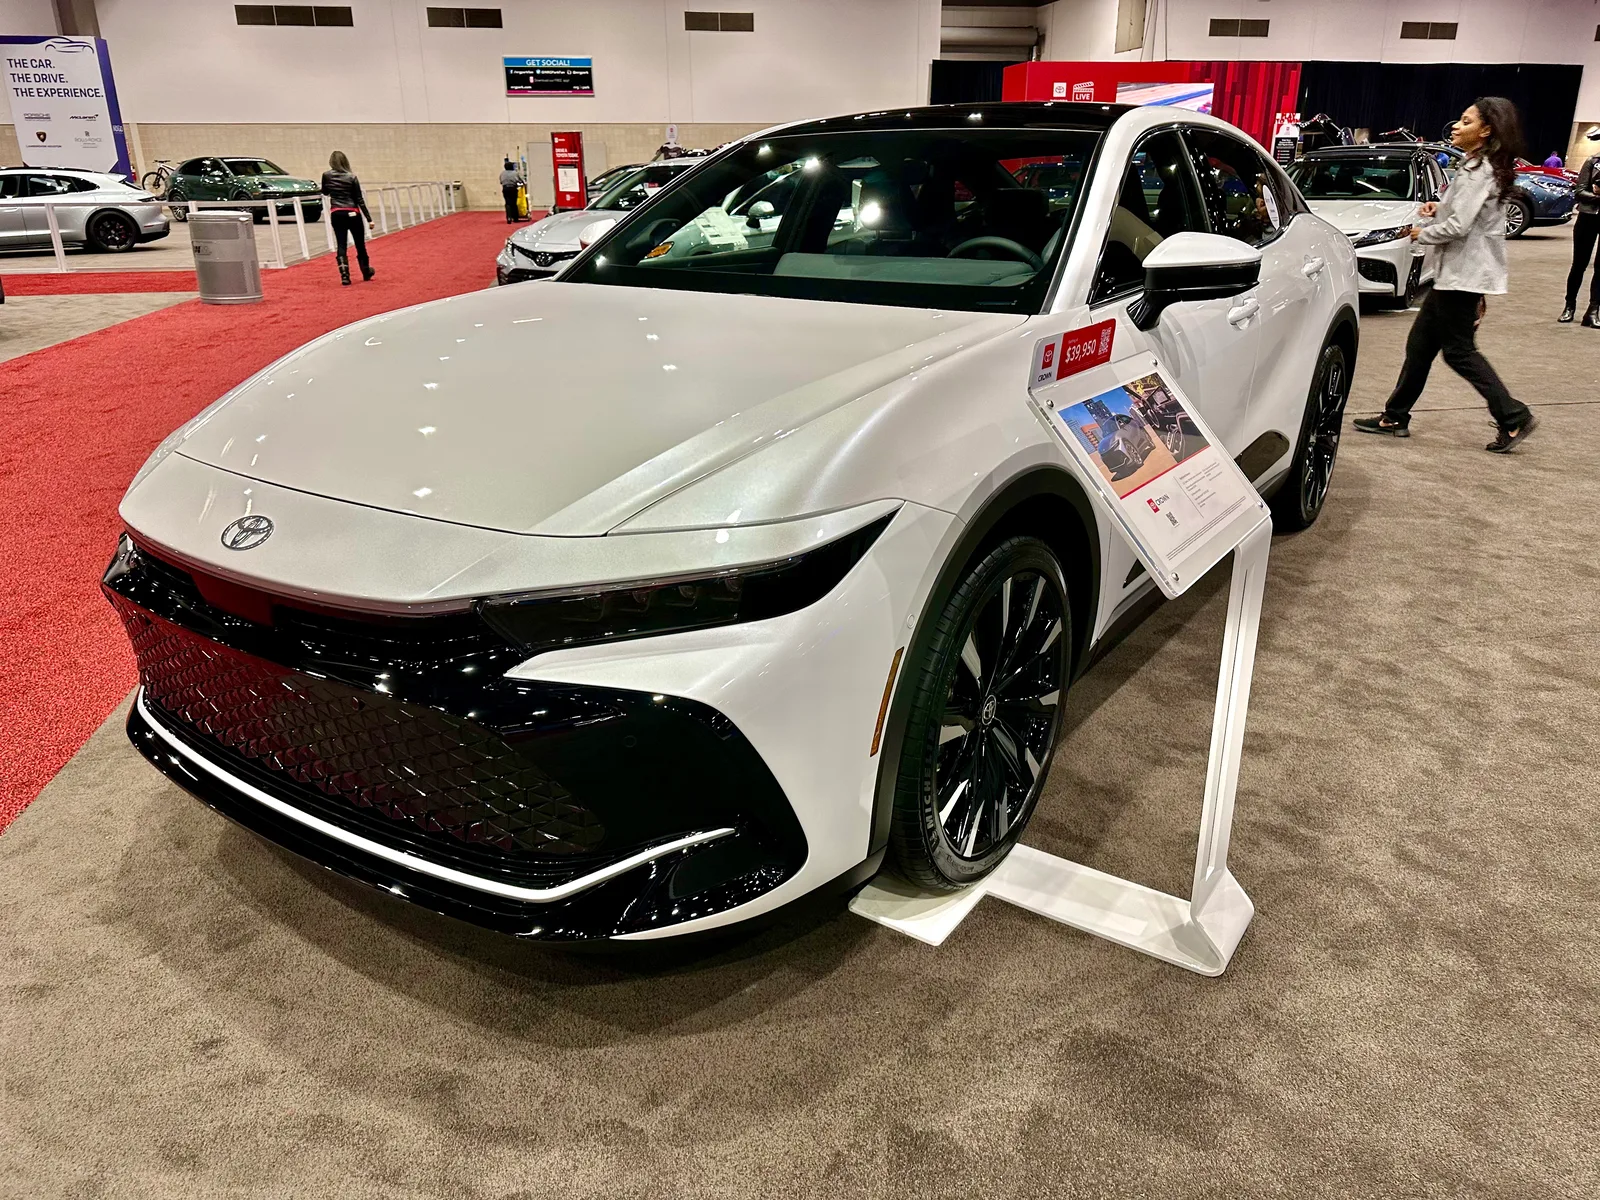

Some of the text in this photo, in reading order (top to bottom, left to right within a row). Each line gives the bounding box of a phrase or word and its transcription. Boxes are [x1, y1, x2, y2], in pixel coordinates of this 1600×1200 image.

[6, 58, 55, 69] THE CAR.
[10, 73, 68, 83] THE DRIVE.
[13, 87, 104, 98] THE EXPERIENCE.
[1065, 339, 1096, 364] $39,950
[1038, 372, 1052, 382] CROWN
